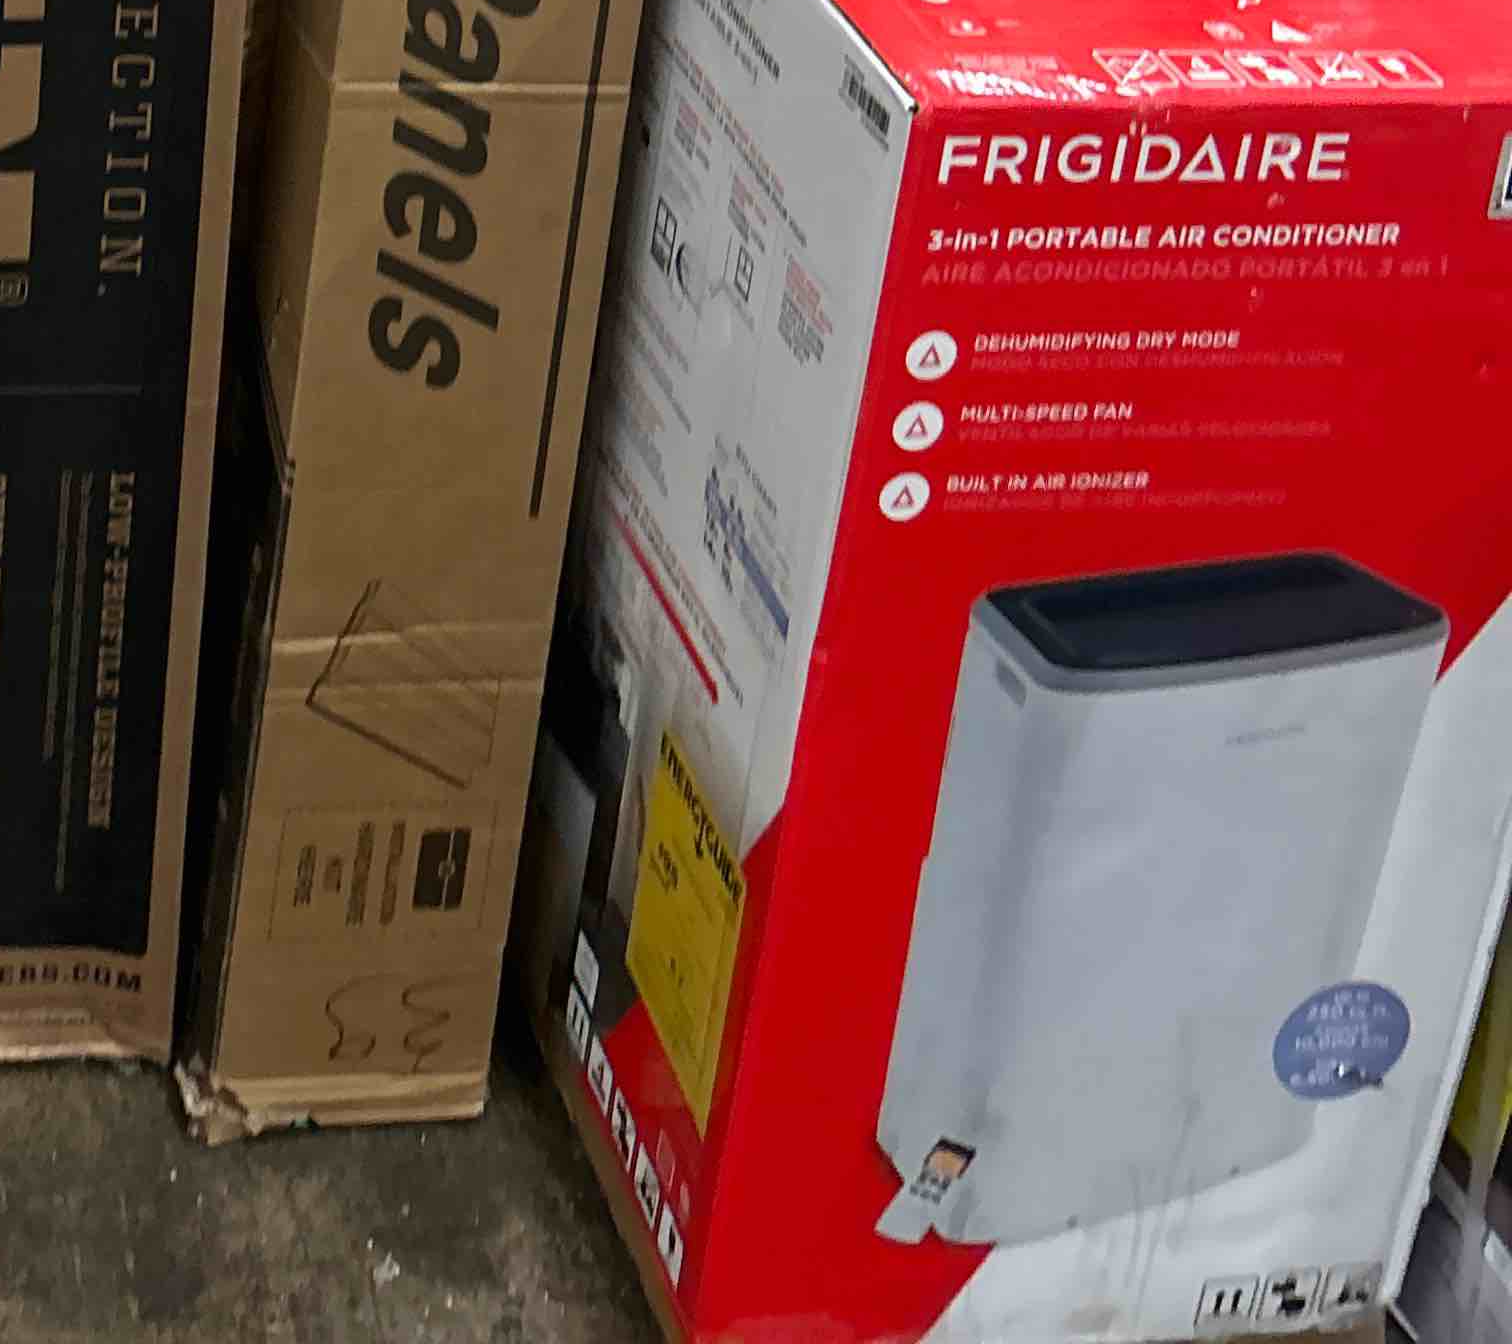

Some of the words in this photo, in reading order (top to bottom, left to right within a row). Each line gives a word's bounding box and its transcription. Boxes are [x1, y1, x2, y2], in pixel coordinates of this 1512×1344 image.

[938, 132, 1351, 185] FRIGIDAIRE
[928, 227, 1001, 253] 3-in-1
[1007, 225, 1153, 251] PORTABLE
[1158, 225, 1207, 249] AIR
[1213, 222, 1401, 249] CONDITIONER
[974, 332, 1131, 353] DEHUMIDIFYING
[1136, 331, 1178, 351] DRY
[1181, 329, 1241, 350] MODE
[960, 403, 1090, 424] MULTI-SPEED
[1093, 401, 1135, 421] FAN
[946, 474, 1003, 493] BUILT
[1007, 474, 1029, 491] IN
[1032, 473, 1067, 491] AIR
[1069, 471, 1151, 490] IONIZER
